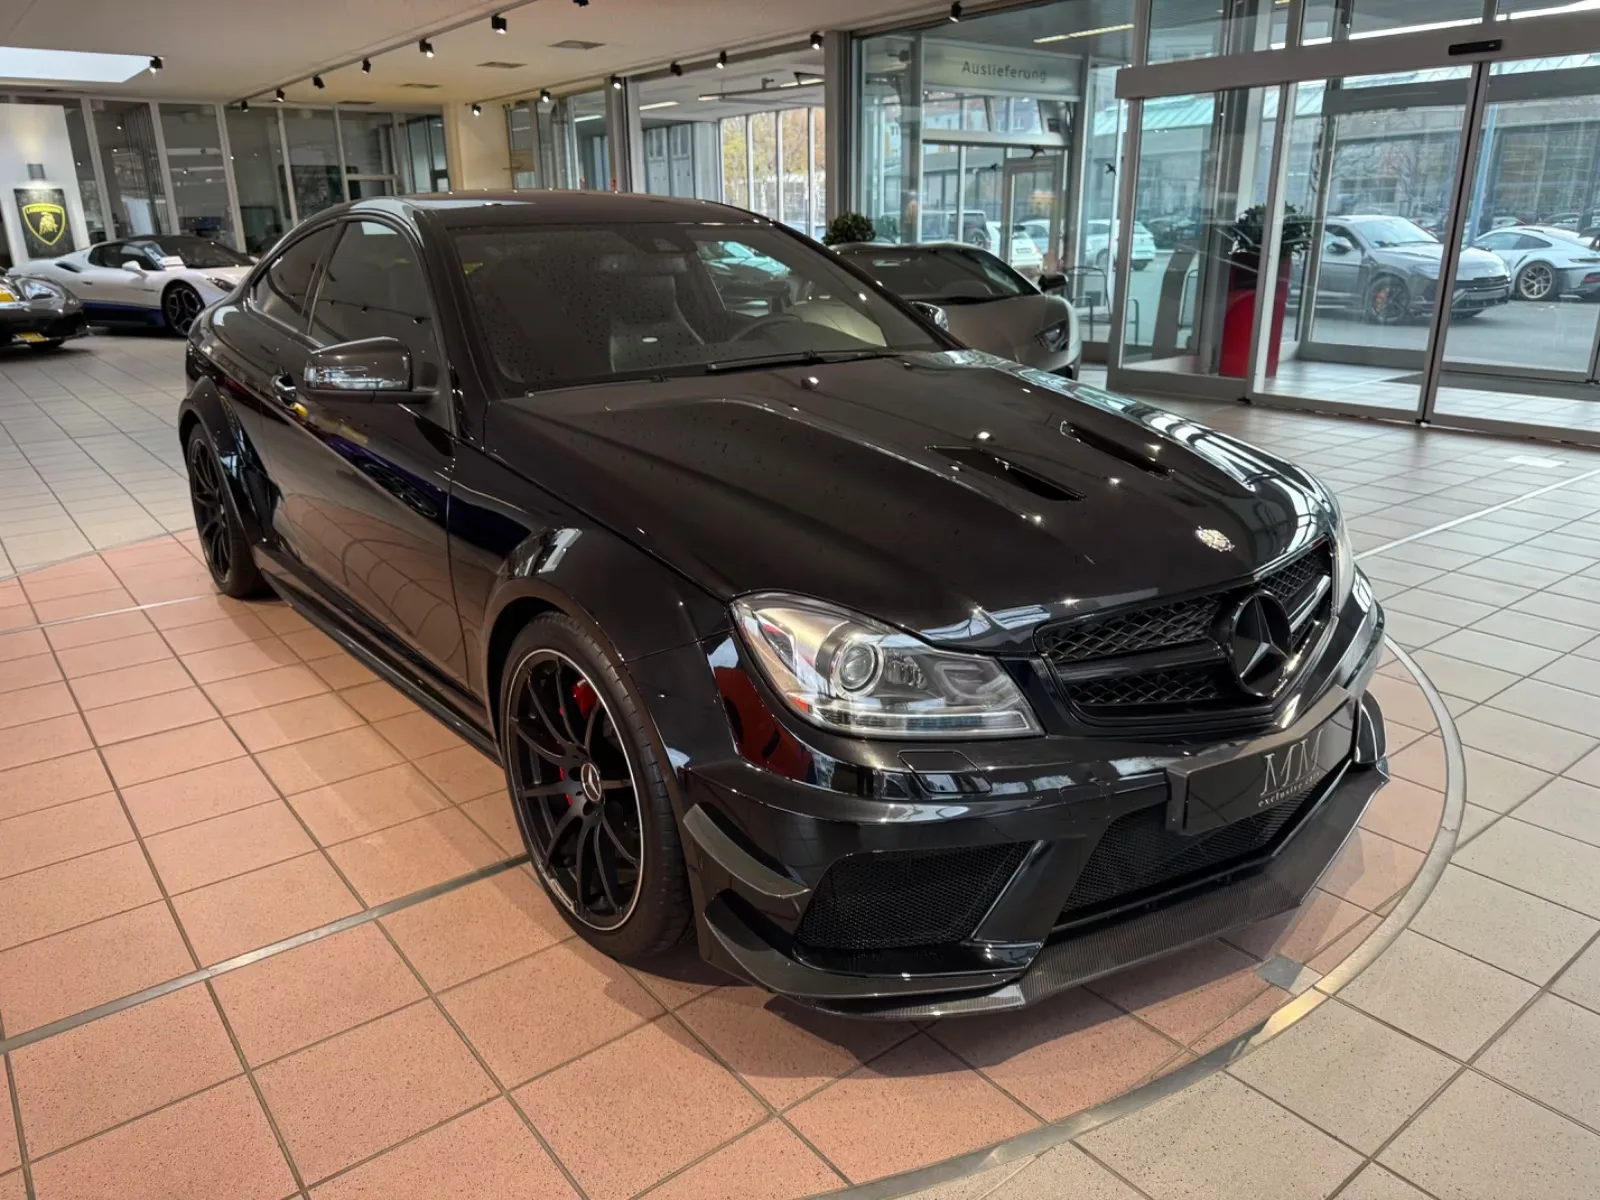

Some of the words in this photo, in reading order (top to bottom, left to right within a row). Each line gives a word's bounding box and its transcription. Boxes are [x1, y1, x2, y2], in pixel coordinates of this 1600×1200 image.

[962, 60, 1047, 84] Auslieferung
[1260, 728, 1324, 797] MM
[1258, 783, 1303, 808] exclusive
